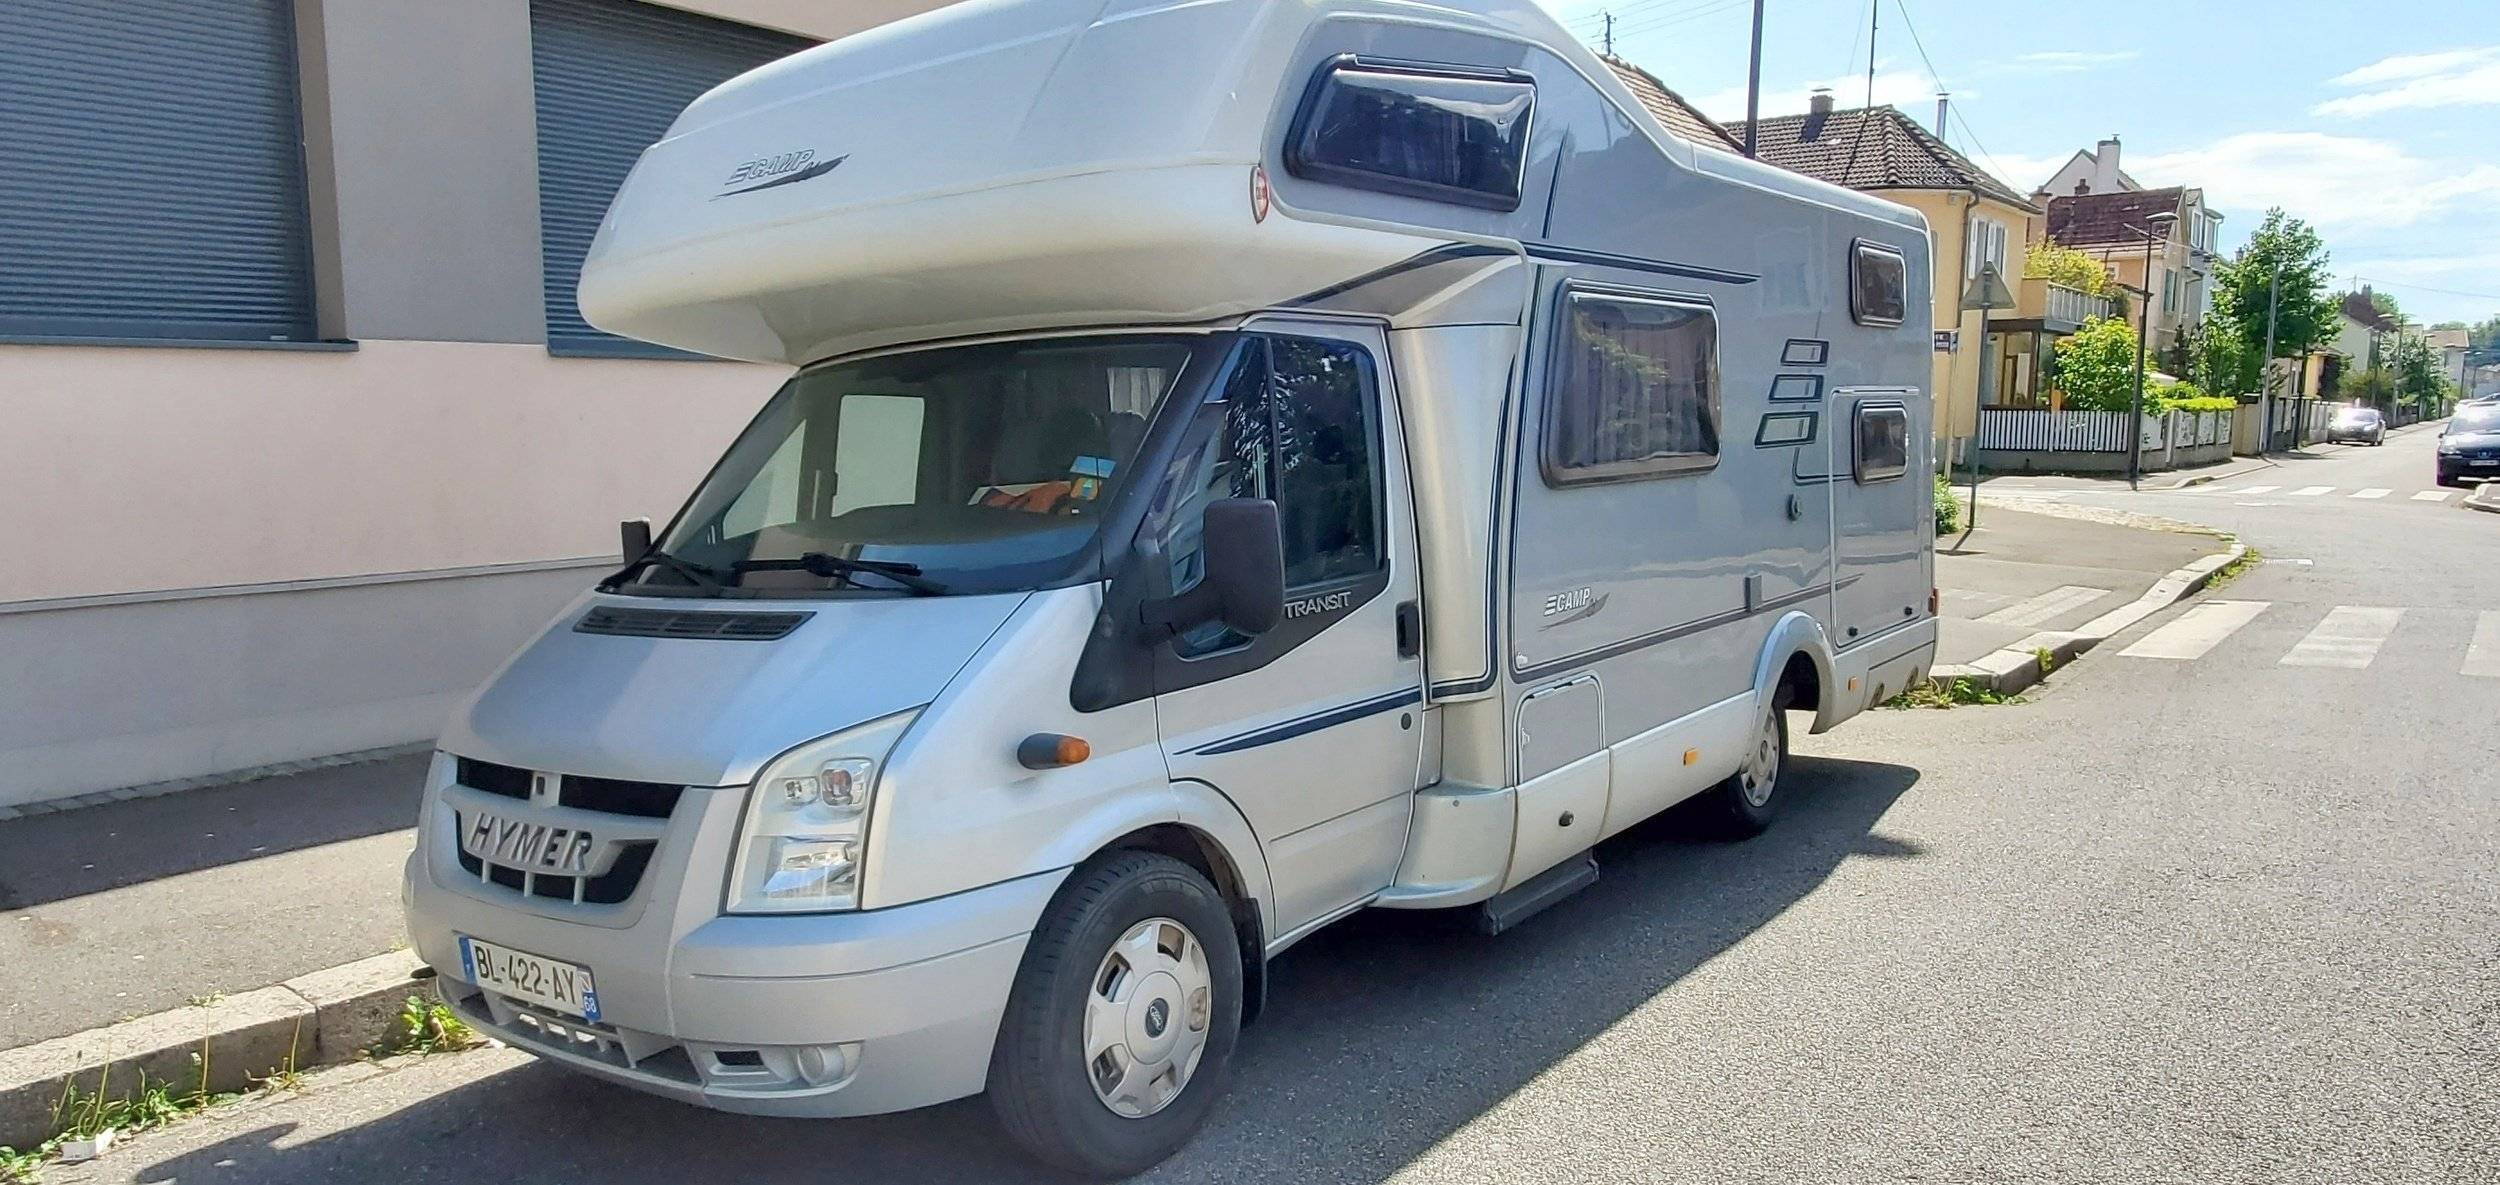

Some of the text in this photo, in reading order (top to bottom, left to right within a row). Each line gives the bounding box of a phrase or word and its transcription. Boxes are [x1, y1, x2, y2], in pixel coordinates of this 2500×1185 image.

[1284, 591, 1352, 619] TRANSIT
[469, 811, 593, 871] HYMER
[474, 945, 576, 1005] BL-422-AY
